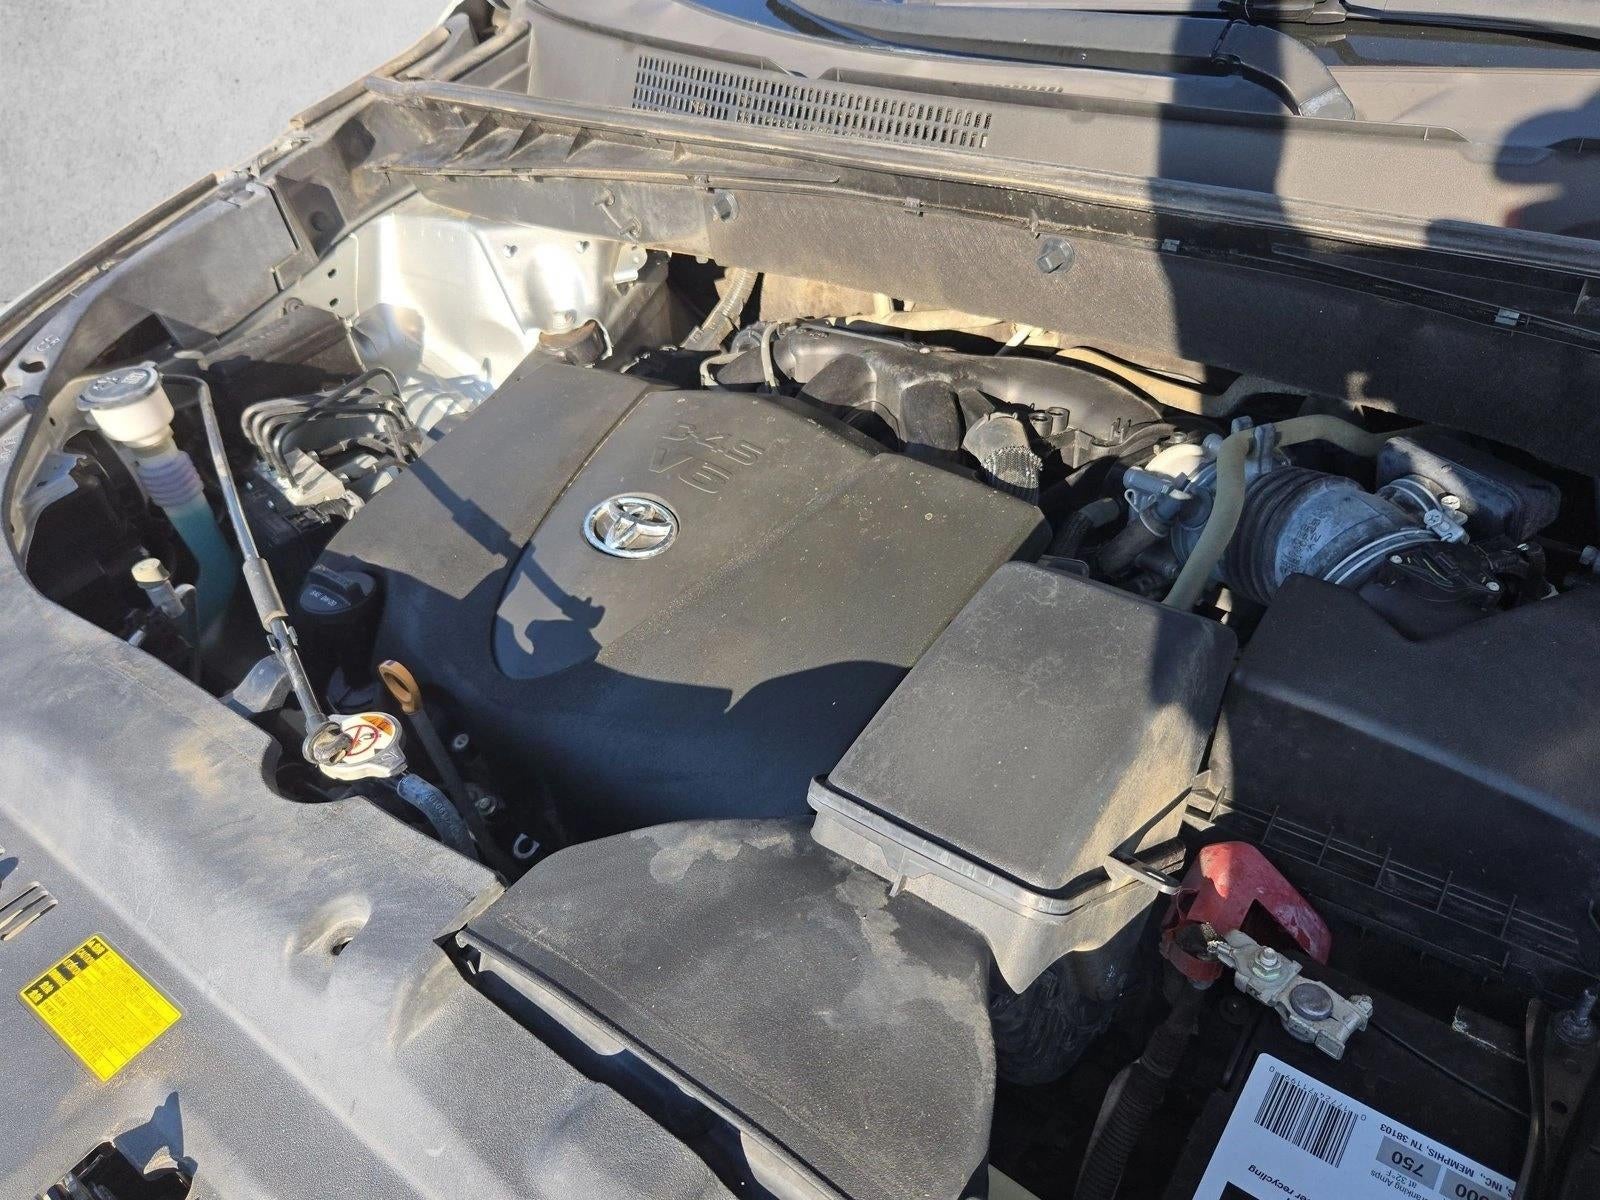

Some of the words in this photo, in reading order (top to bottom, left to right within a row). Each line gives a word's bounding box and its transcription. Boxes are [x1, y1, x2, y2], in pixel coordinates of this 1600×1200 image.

[648, 448, 734, 494] V6
[1380, 1123, 1409, 1143] 38103
[1410, 1140, 1424, 1152] TN
[1391, 1151, 1425, 1178] 750
[1426, 1146, 1475, 1178] MEMPHIS,
[1248, 1164, 1294, 1195] recycling
[1370, 1169, 1394, 1187] Amps
